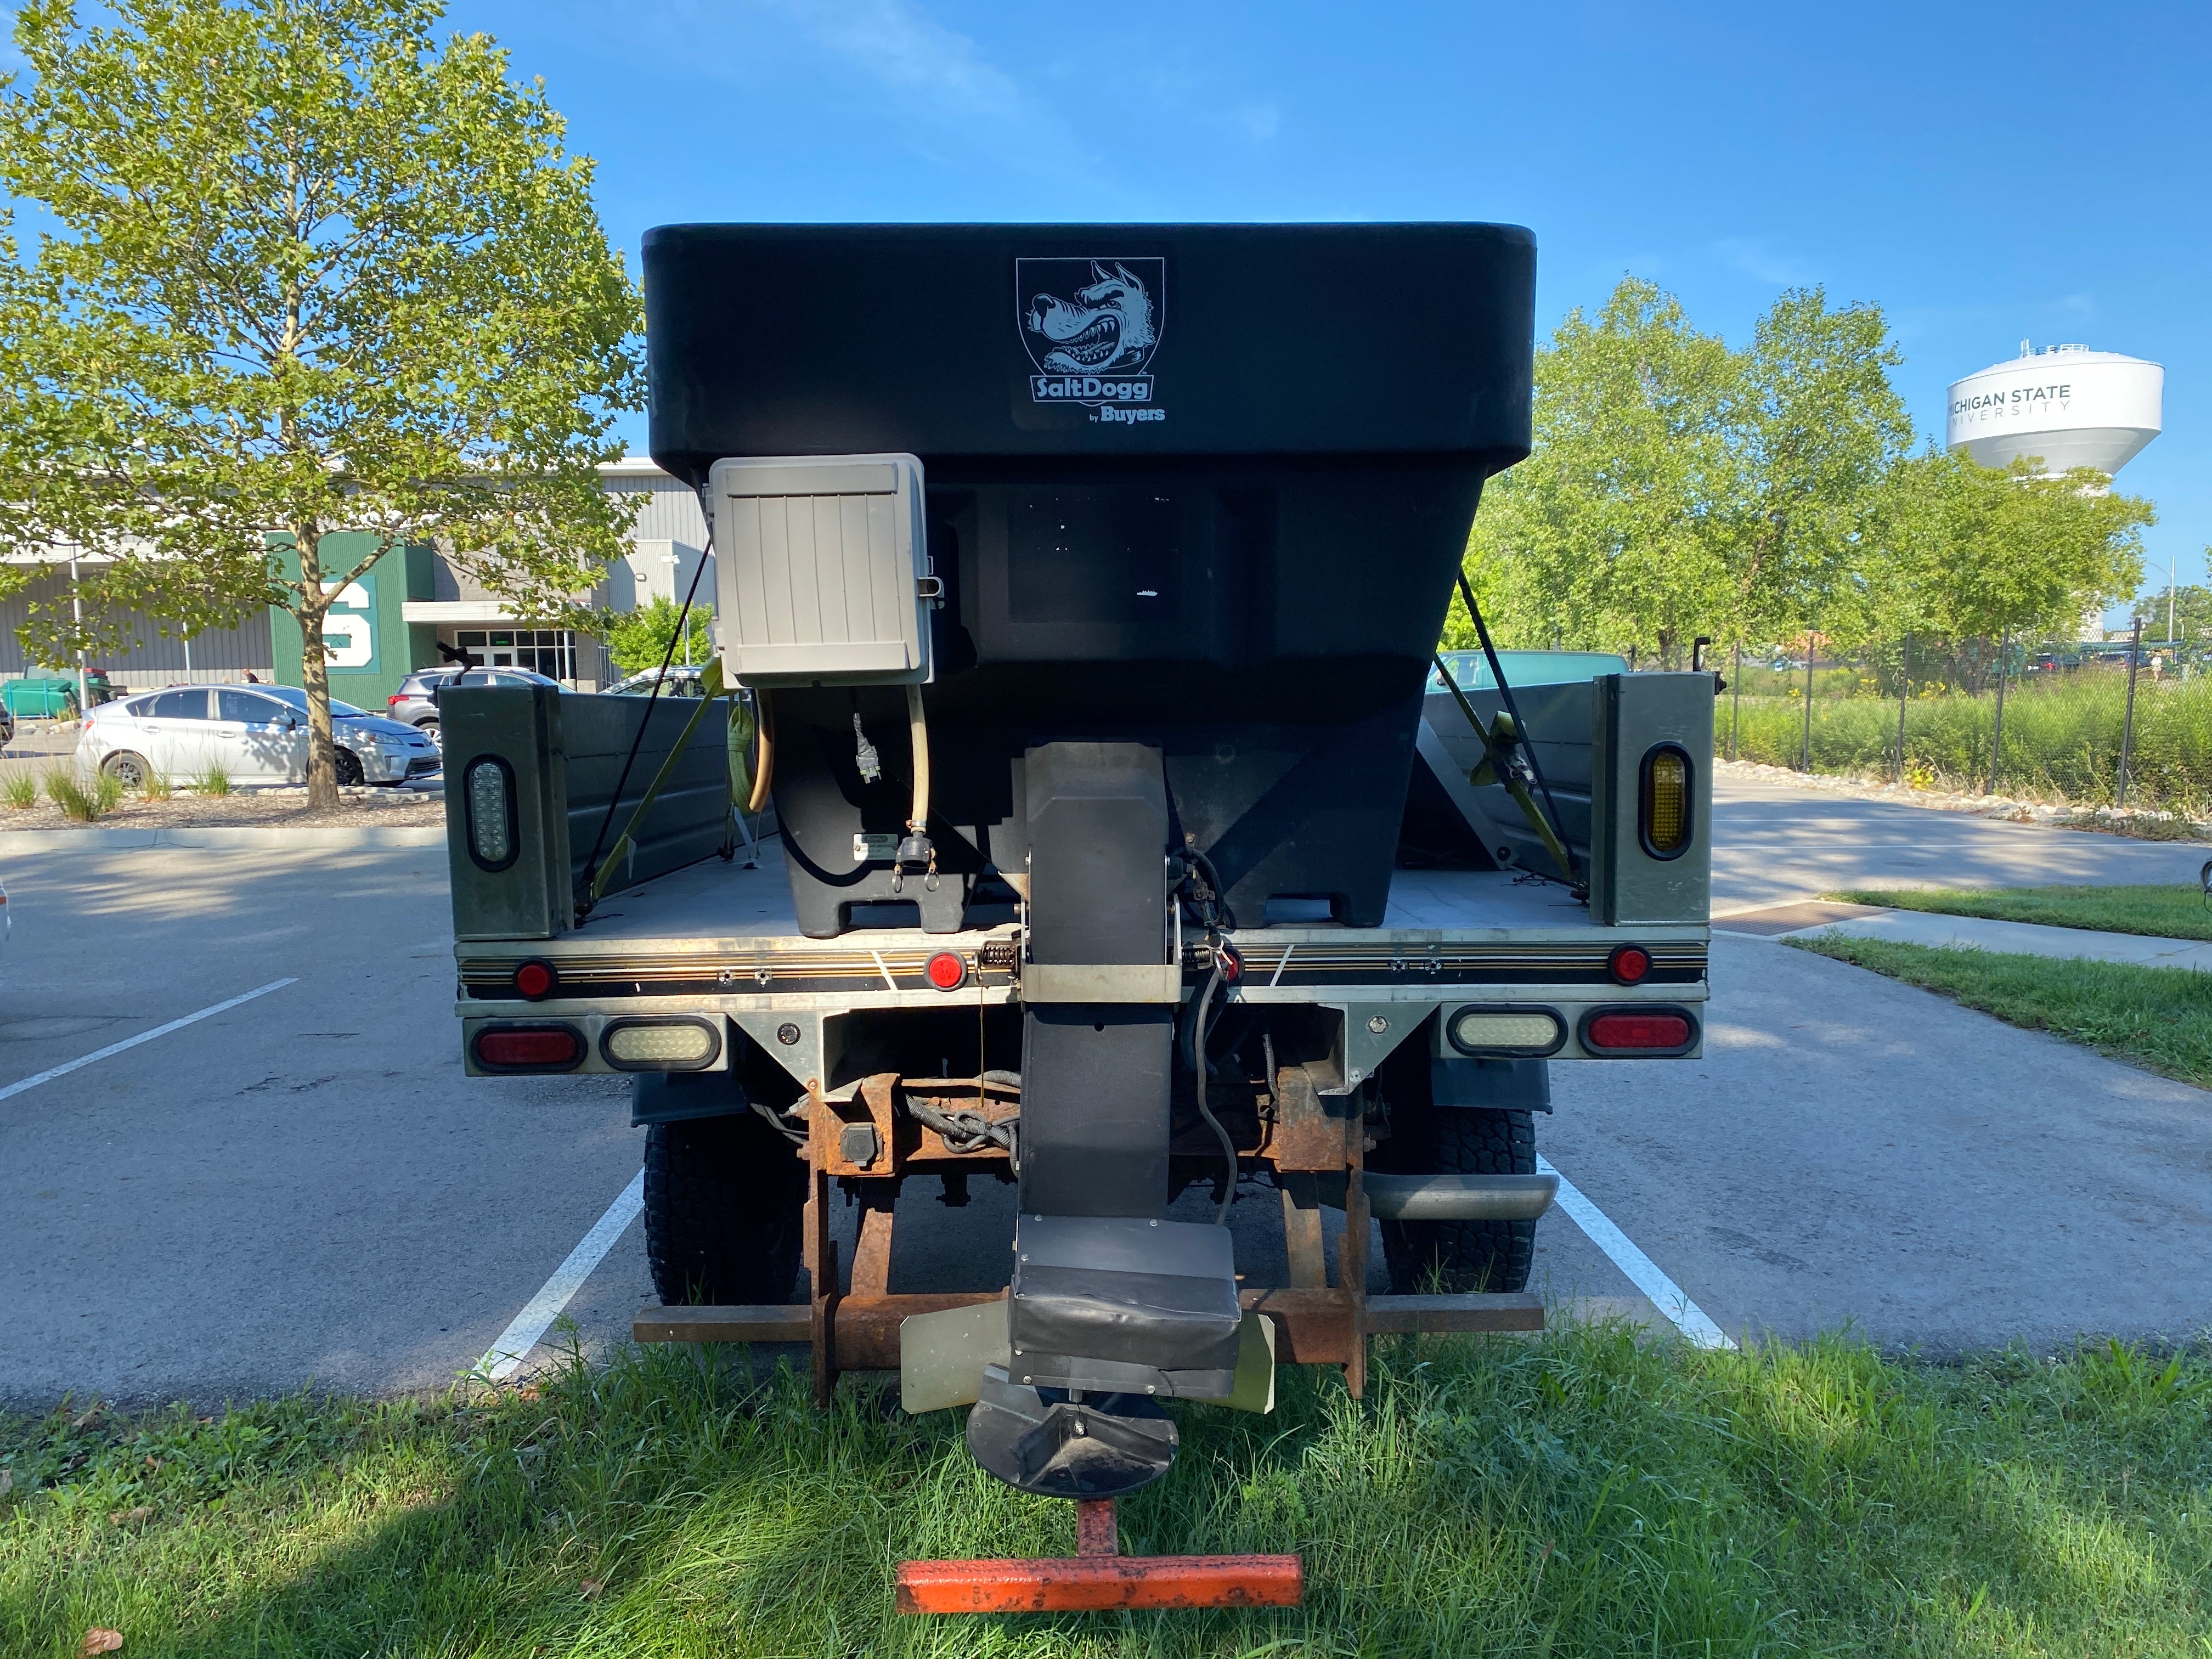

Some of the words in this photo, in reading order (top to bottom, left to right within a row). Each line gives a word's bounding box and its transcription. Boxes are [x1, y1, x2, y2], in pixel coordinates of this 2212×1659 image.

[1037, 377, 1148, 399] SaltDogg
[1949, 392, 2005, 416] MICHIGAN
[2011, 385, 2070, 403] STATE
[1089, 414, 1098, 422] by
[1101, 406, 1165, 425] Buyers
